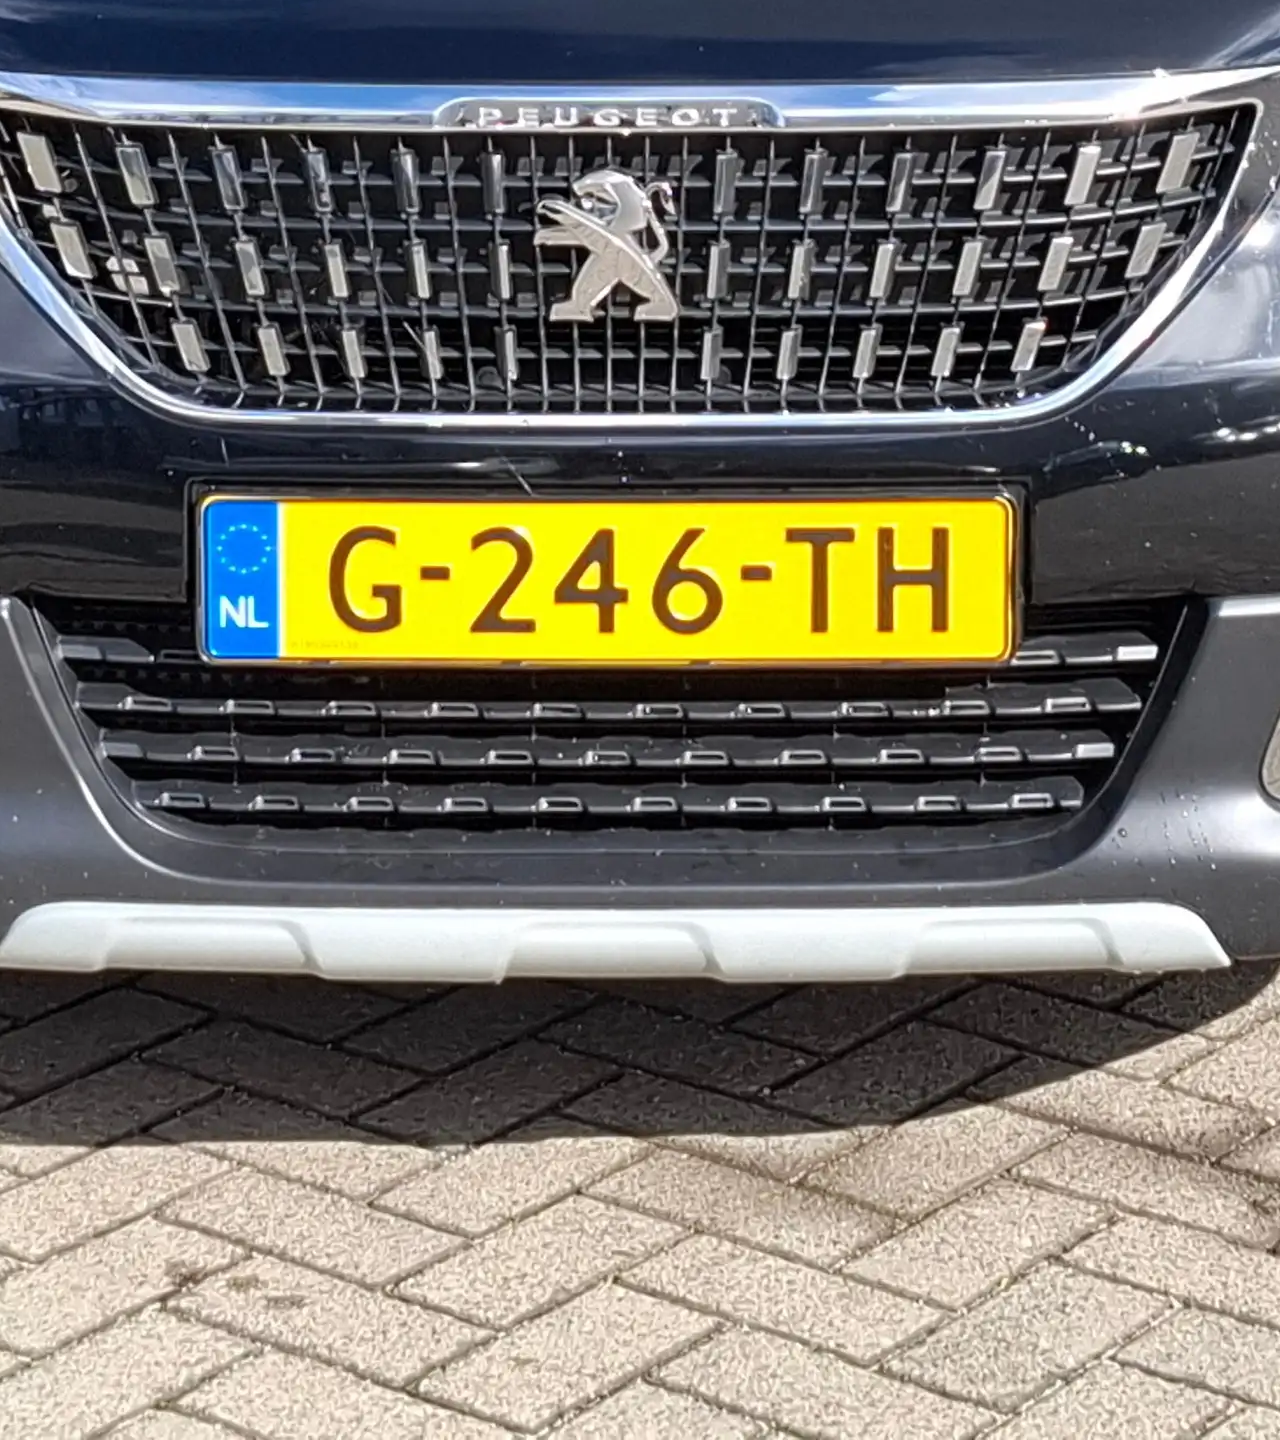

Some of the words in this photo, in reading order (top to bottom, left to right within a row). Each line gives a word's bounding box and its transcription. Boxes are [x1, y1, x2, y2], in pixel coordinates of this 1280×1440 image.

[478, 106, 738, 127] PEUGEOT
[328, 525, 950, 635] G-246-TH
[219, 595, 270, 629] NL
